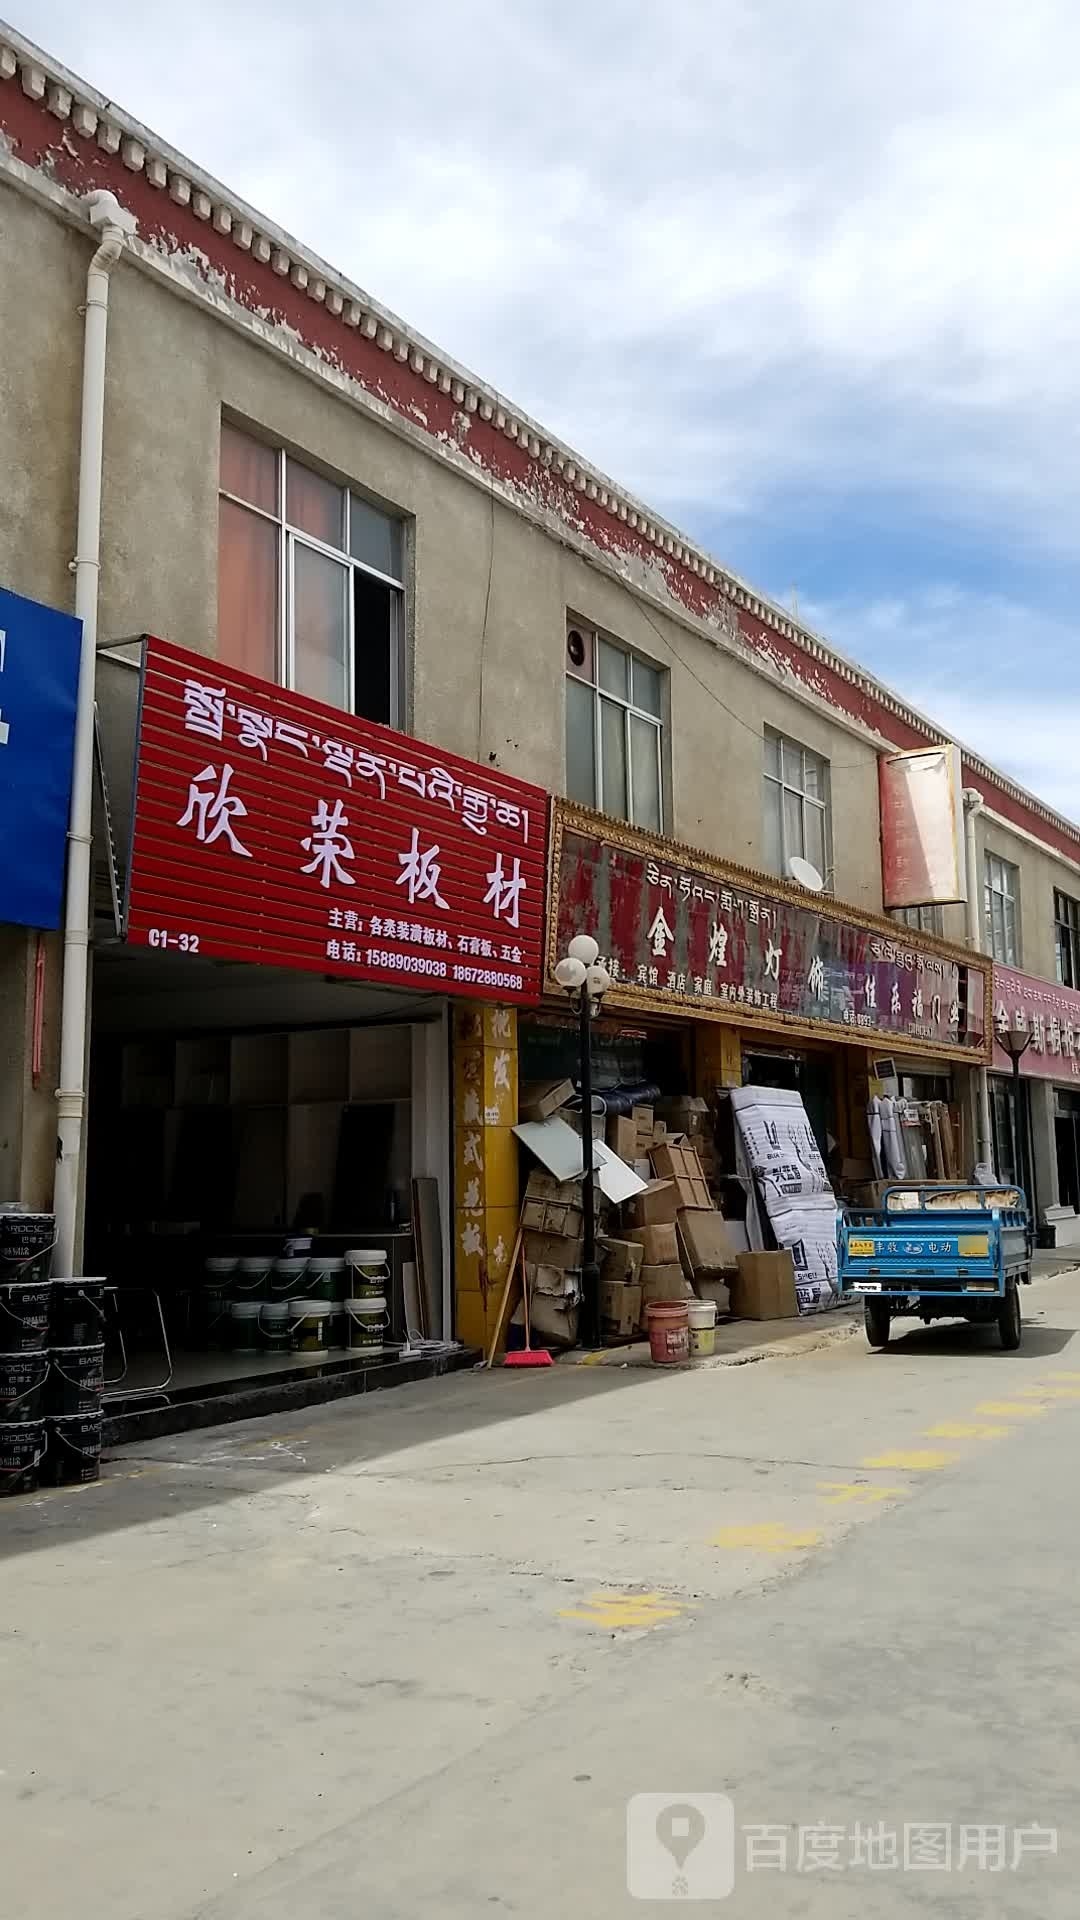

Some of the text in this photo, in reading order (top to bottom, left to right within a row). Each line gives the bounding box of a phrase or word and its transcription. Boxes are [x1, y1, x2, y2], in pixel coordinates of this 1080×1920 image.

[177, 763, 528, 928] 欣荣板材
[148, 928, 200, 953] C1-32
[453, 964, 523, 991] 18672880568
[637, 963, 659, 986] 宾馆
[667, 970, 686, 992] 酒店
[693, 976, 713, 996] 家庭
[928, 1242, 952, 1253] 电动
